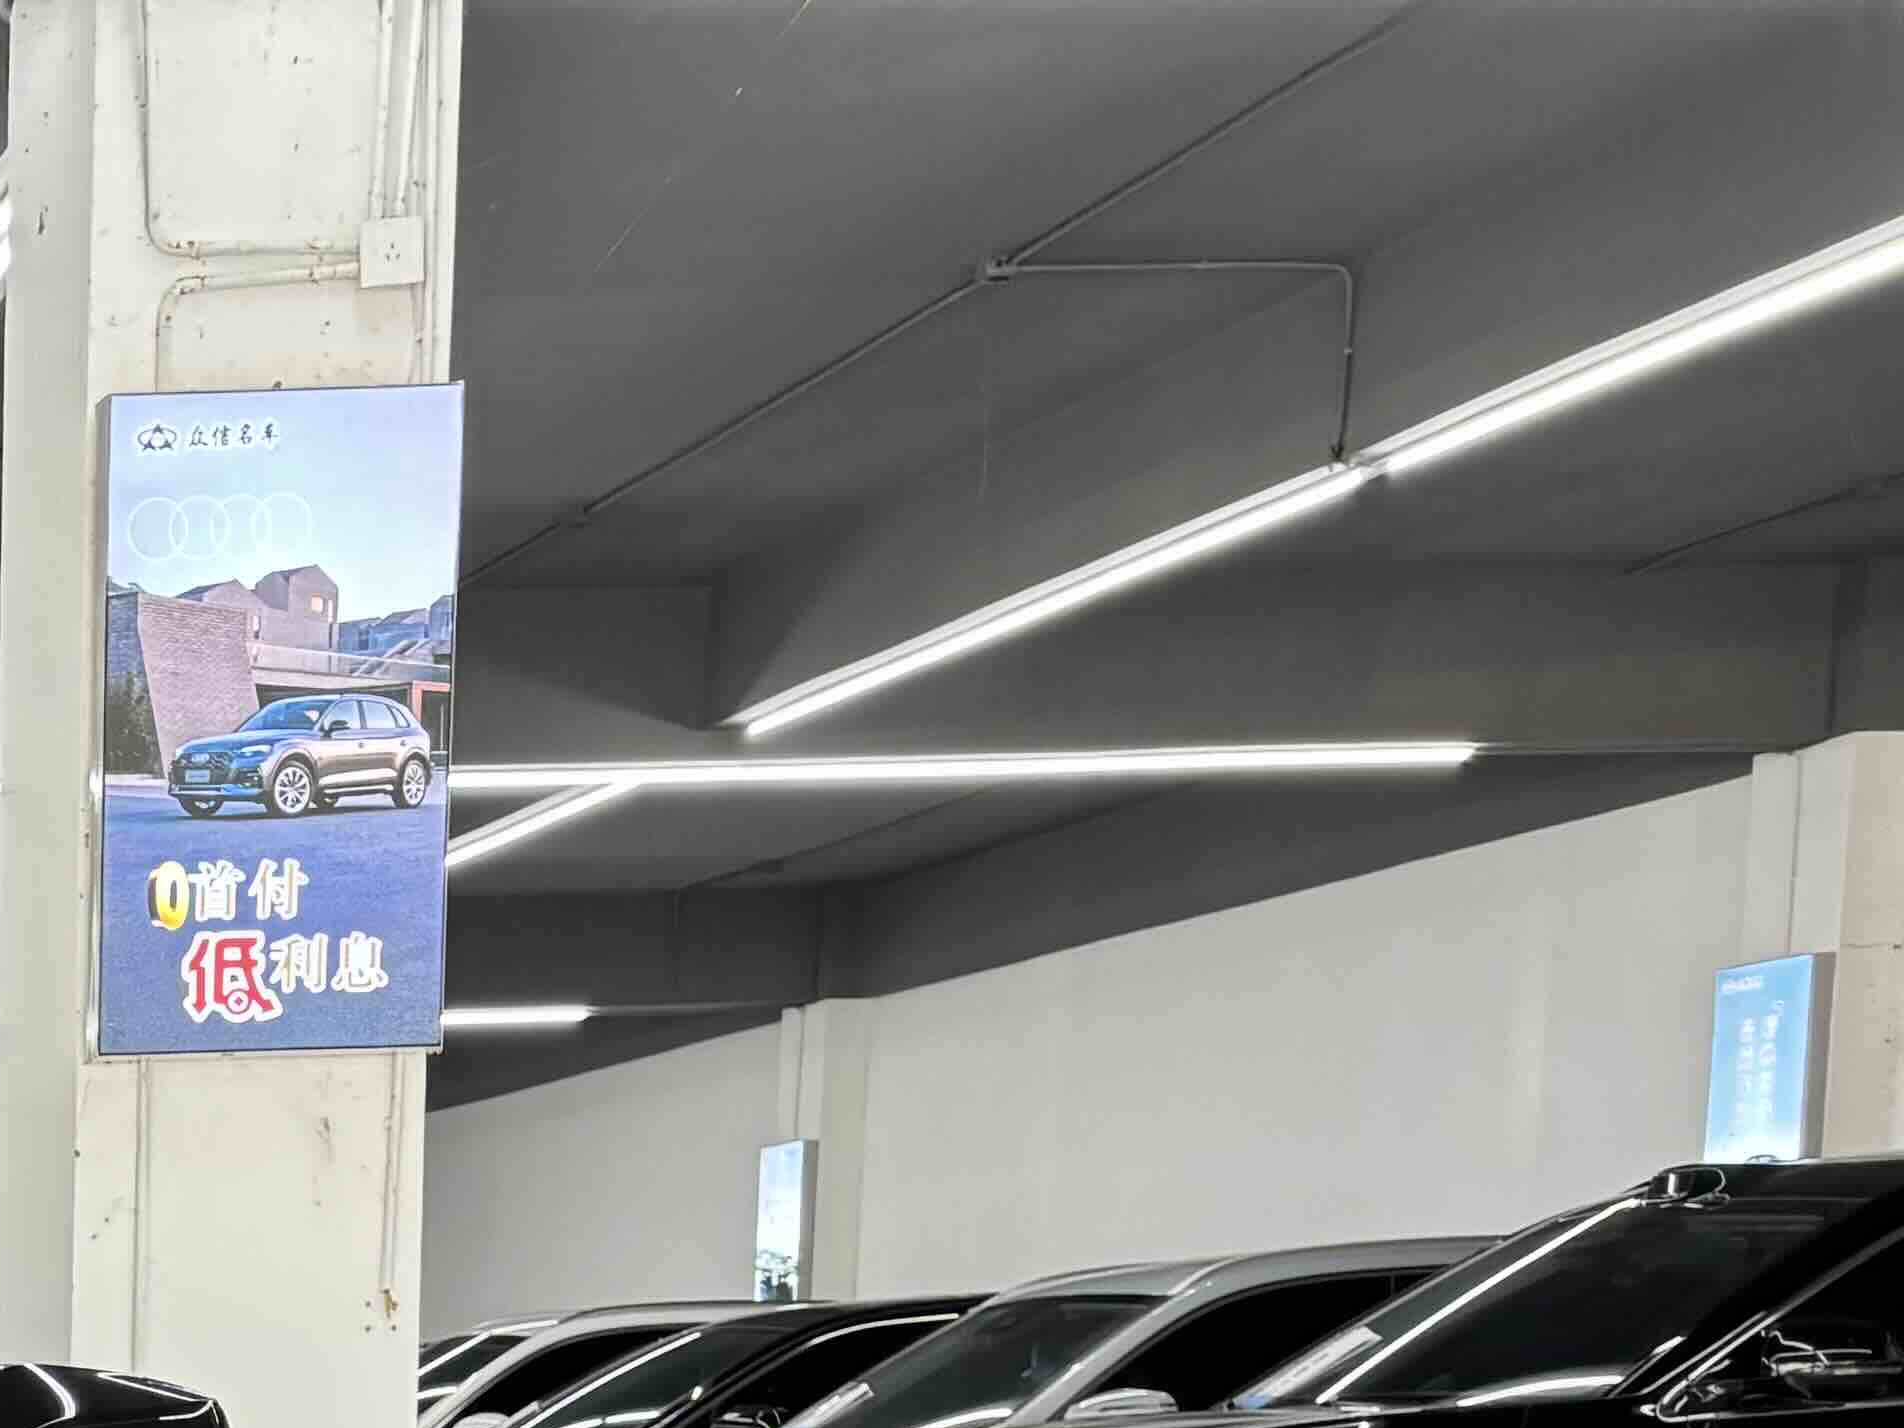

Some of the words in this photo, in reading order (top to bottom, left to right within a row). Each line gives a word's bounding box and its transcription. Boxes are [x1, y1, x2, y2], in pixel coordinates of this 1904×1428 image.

[148, 858, 310, 930] 0首付
[182, 929, 389, 1022] 低利息
